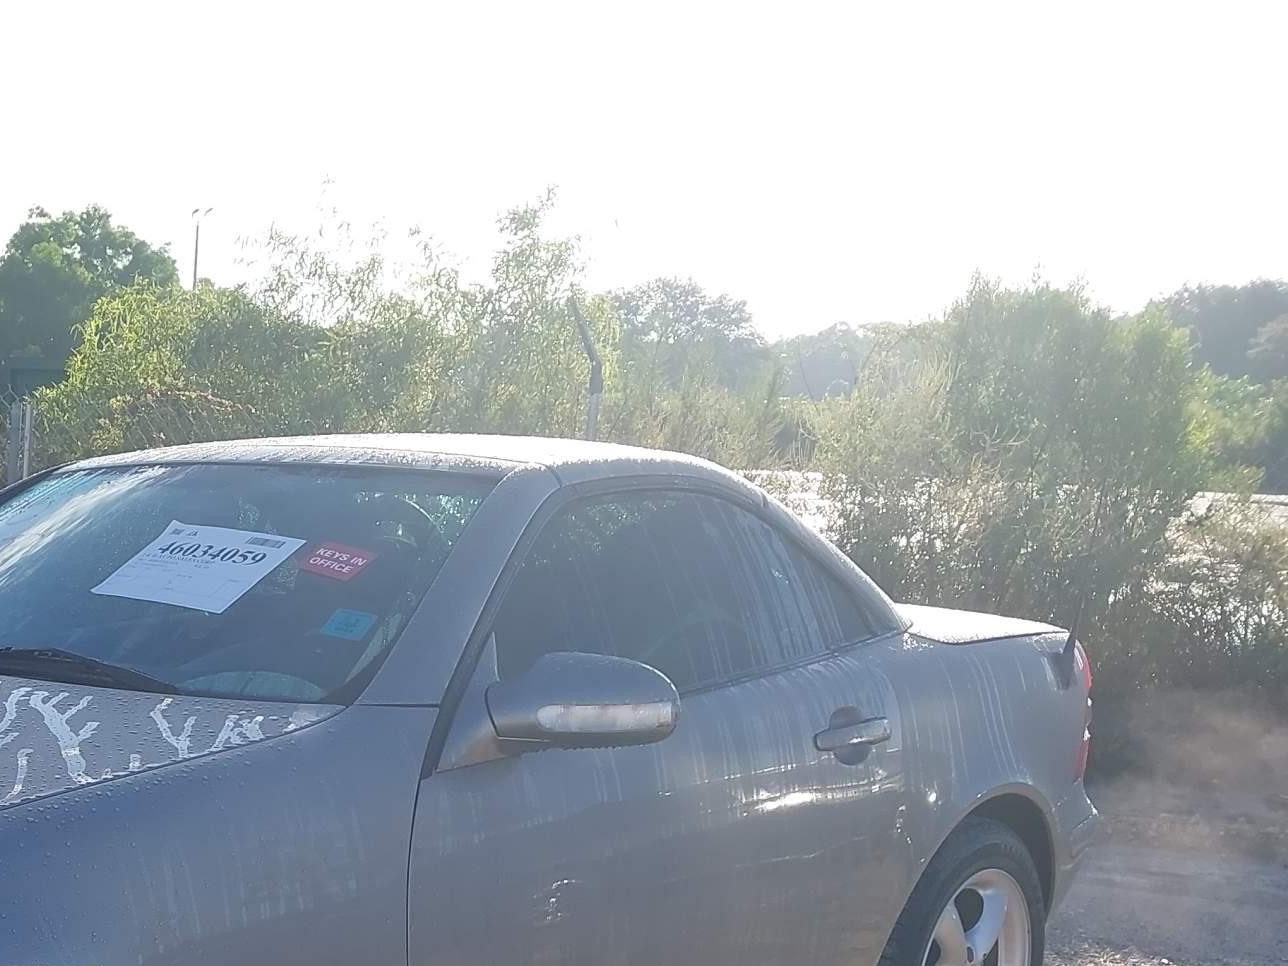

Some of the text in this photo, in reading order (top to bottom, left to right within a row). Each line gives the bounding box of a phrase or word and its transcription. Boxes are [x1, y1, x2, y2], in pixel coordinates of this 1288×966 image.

[157, 541, 268, 566] 46034059
[315, 548, 368, 566] KEYS IN
[309, 556, 354, 573] OFFICE
